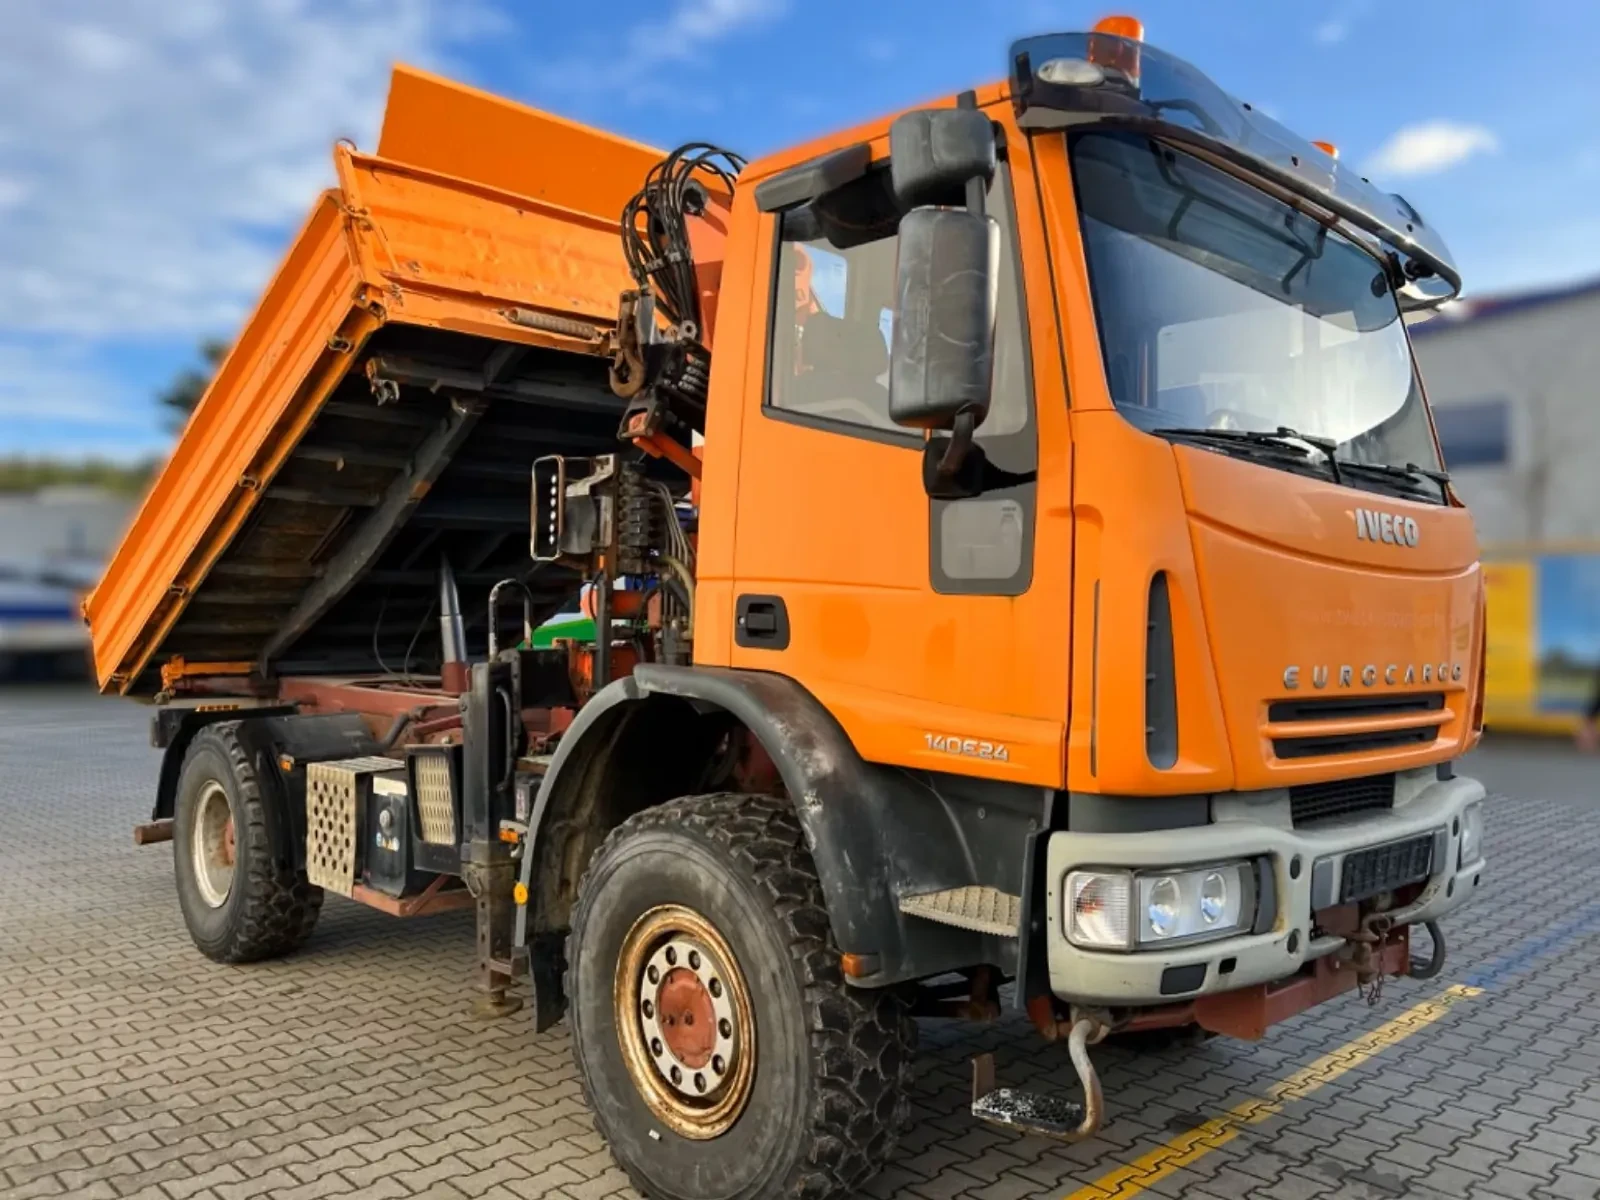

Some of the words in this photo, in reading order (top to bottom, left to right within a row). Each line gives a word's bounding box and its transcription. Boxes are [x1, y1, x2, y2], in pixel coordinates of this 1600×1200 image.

[1355, 508, 1418, 547] IVECO
[1283, 663, 1462, 690] EUROCARGO
[924, 732, 1009, 761] 140E24
